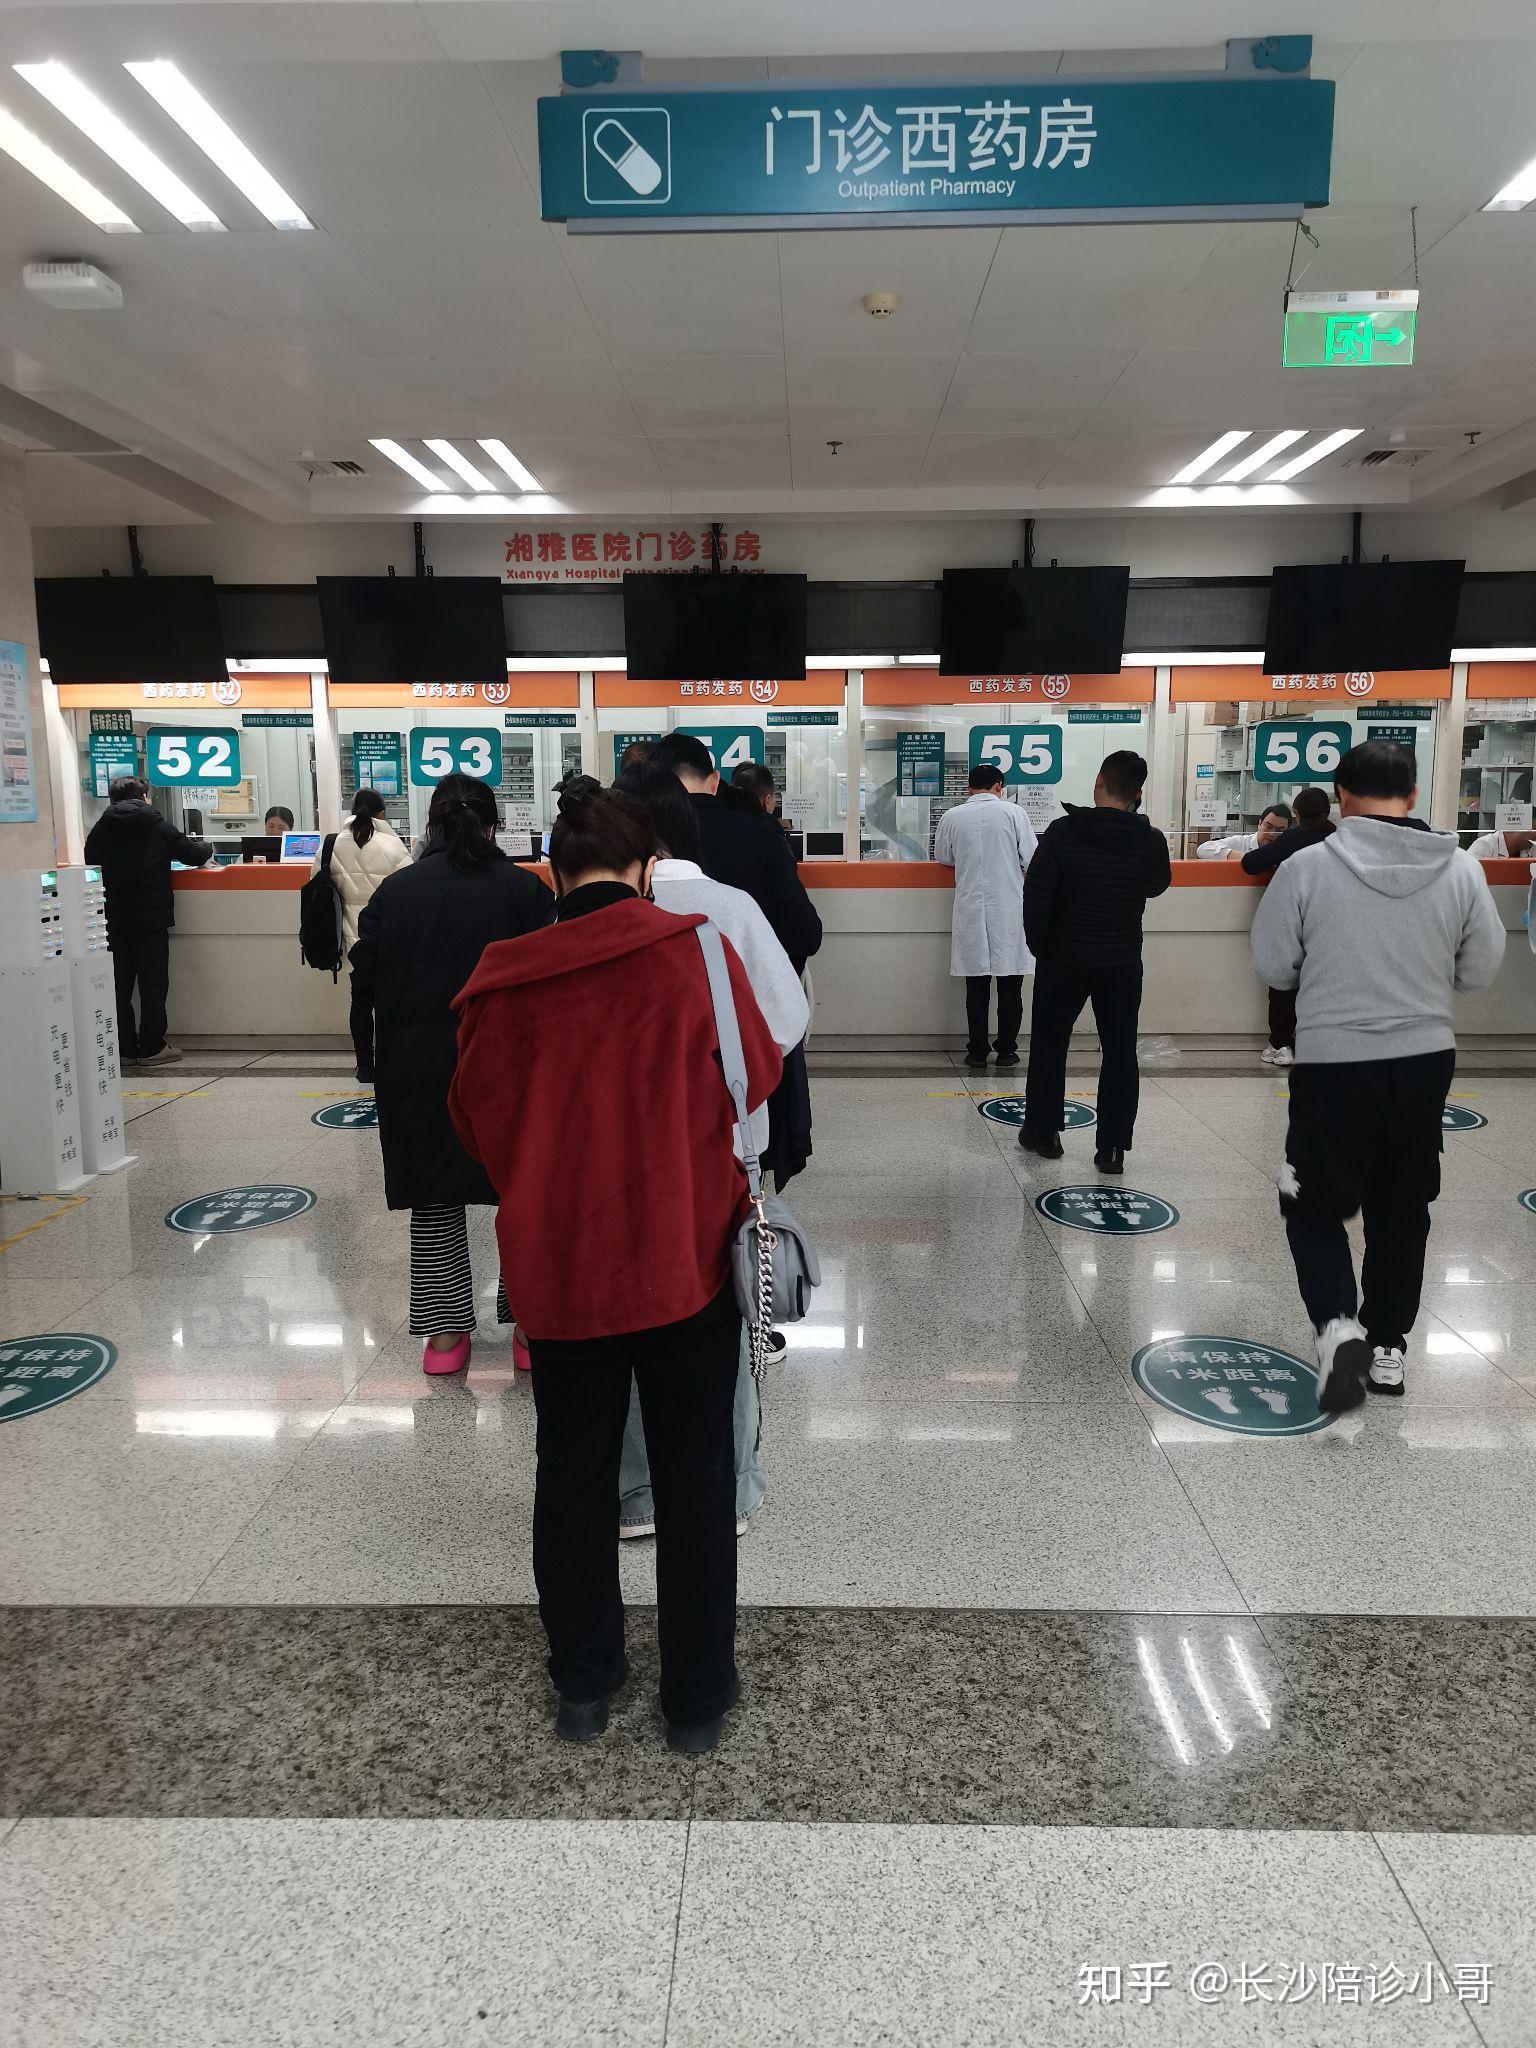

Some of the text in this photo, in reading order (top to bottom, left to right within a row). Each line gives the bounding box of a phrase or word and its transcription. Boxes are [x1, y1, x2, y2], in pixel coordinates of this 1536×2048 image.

[766, 98, 1098, 177] 门诊西药房
[838, 178, 1016, 201] Outpatient Pharmacy
[504, 530, 762, 563] 湘雅医院门诊药房
[506, 568, 559, 581] Xiangya
[565, 567, 620, 581] Hospital
[142, 681, 206, 698] 西药发药
[411, 682, 476, 698] 西药发药
[680, 680, 743, 696] 西药发药
[968, 677, 1033, 694] 西药发药
[1272, 673, 1337, 690] 西药发药
[156, 736, 232, 777] 52
[420, 736, 493, 777] 53
[978, 734, 1053, 775] 55
[1264, 731, 1341, 773] 56
[222, 1192, 299, 1200] 请保持
[1060, 1192, 1136, 1200] 请保持
[1059, 1201, 1151, 1209] 1米距离
[1163, 1350, 1272, 1364] 请保持
[0, 1366, 84, 1379] 距离
[1165, 1368, 1297, 1382] 1米距离
